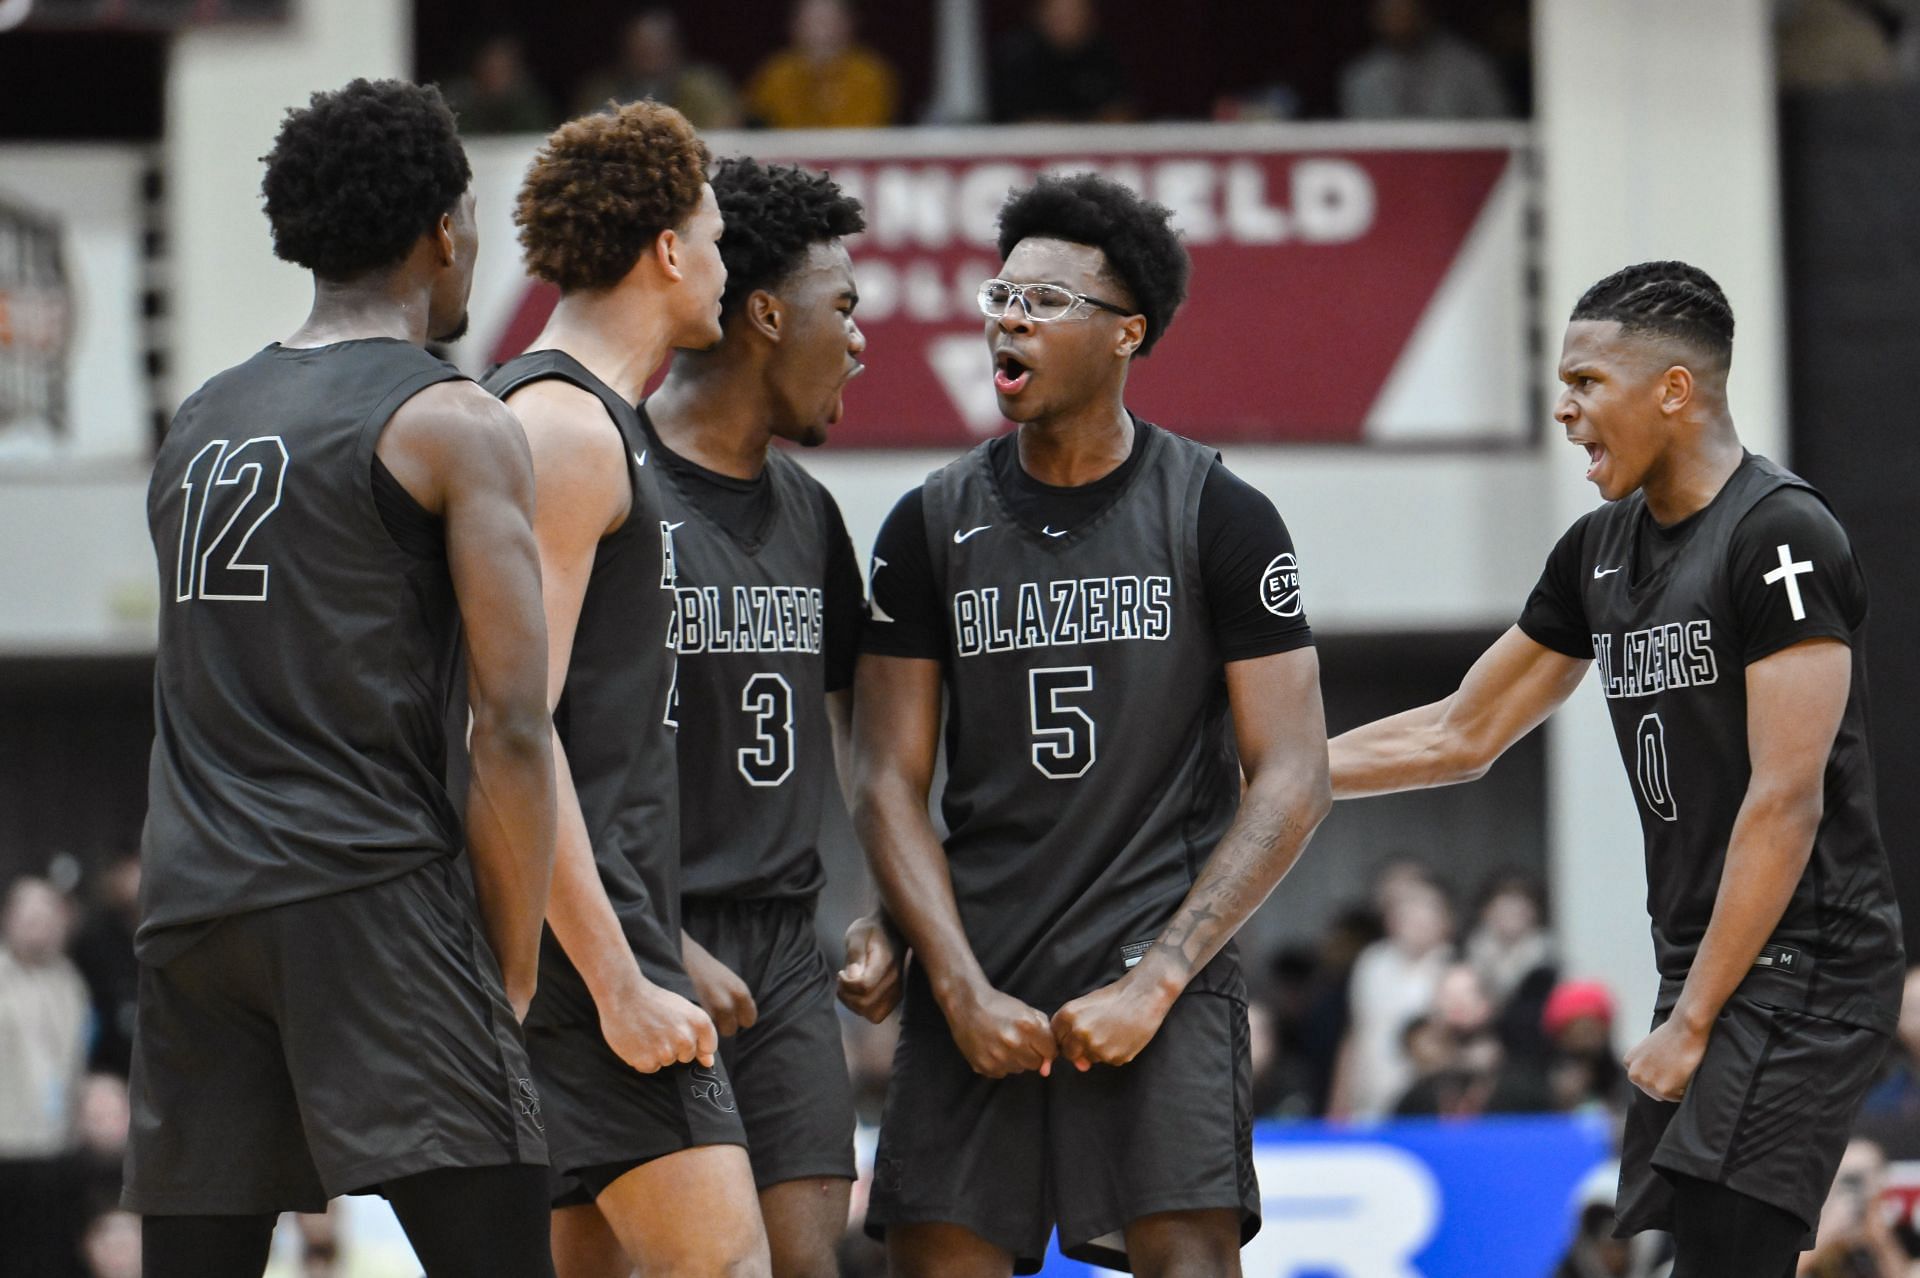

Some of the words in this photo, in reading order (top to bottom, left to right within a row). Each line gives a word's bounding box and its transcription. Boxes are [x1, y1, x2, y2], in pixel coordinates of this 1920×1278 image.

[176, 436, 290, 603] 12
[675, 586, 823, 654] BLAZERS
[954, 575, 1171, 657] BLAZERS
[1268, 571, 1301, 593] EYB
[738, 672, 794, 787] 3
[1028, 665, 1096, 780] 5
[1636, 712, 1678, 822] 0
[1779, 952, 1793, 966] M
